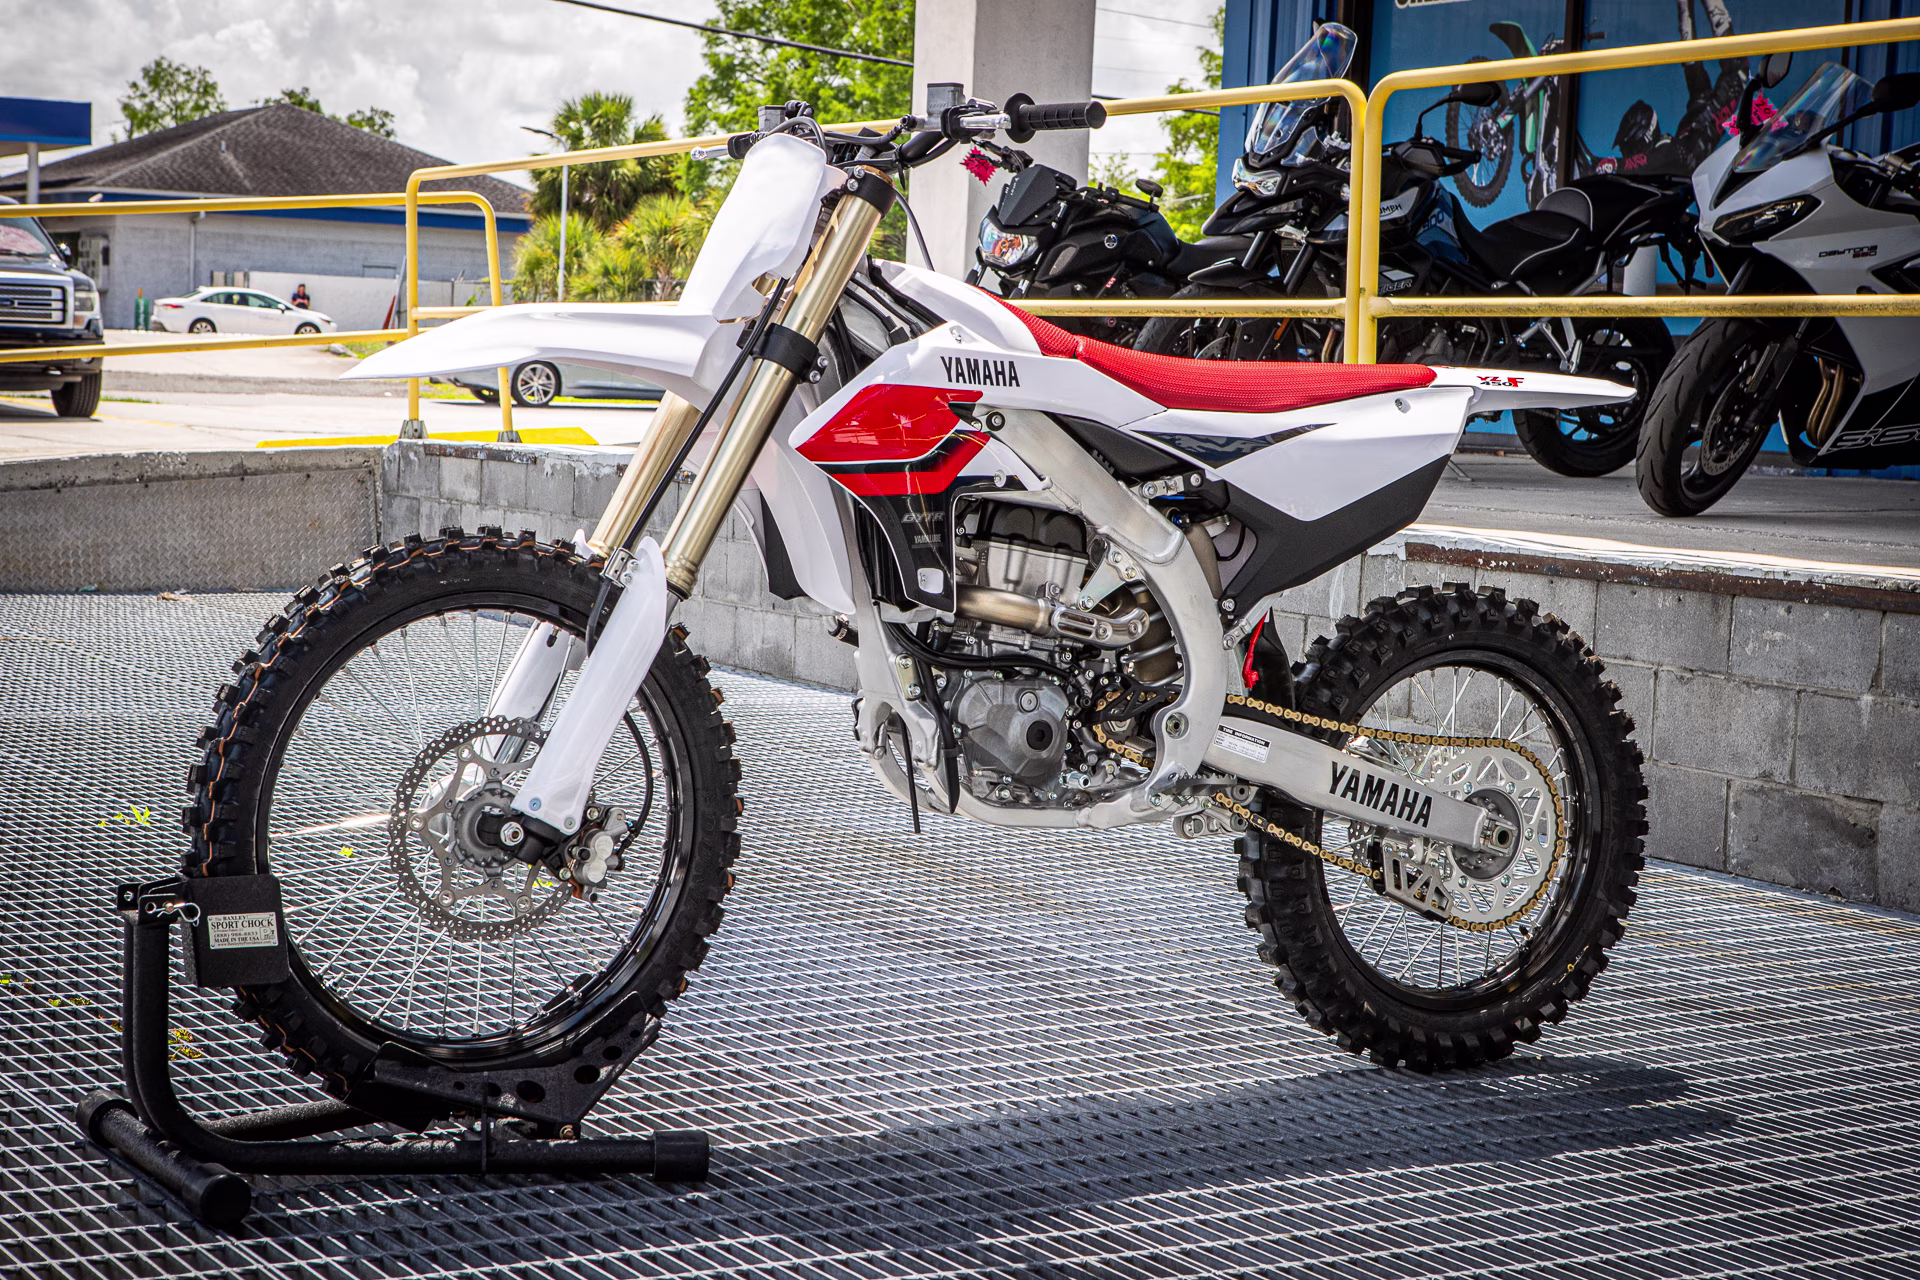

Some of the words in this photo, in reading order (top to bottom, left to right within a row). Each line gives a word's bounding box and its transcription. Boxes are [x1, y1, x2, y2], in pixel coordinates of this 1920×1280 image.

[1380, 203, 1402, 214] UMPH
[940, 355, 1020, 387] YAMAHA
[901, 511, 944, 523] GYTR
[914, 533, 942, 544] YAMALUBE
[1234, 732, 1266, 745] INFORMATION
[1328, 760, 1433, 828] YAMAHA
[211, 920, 239, 930] SPORT
[241, 918, 274, 928] CHOCK
